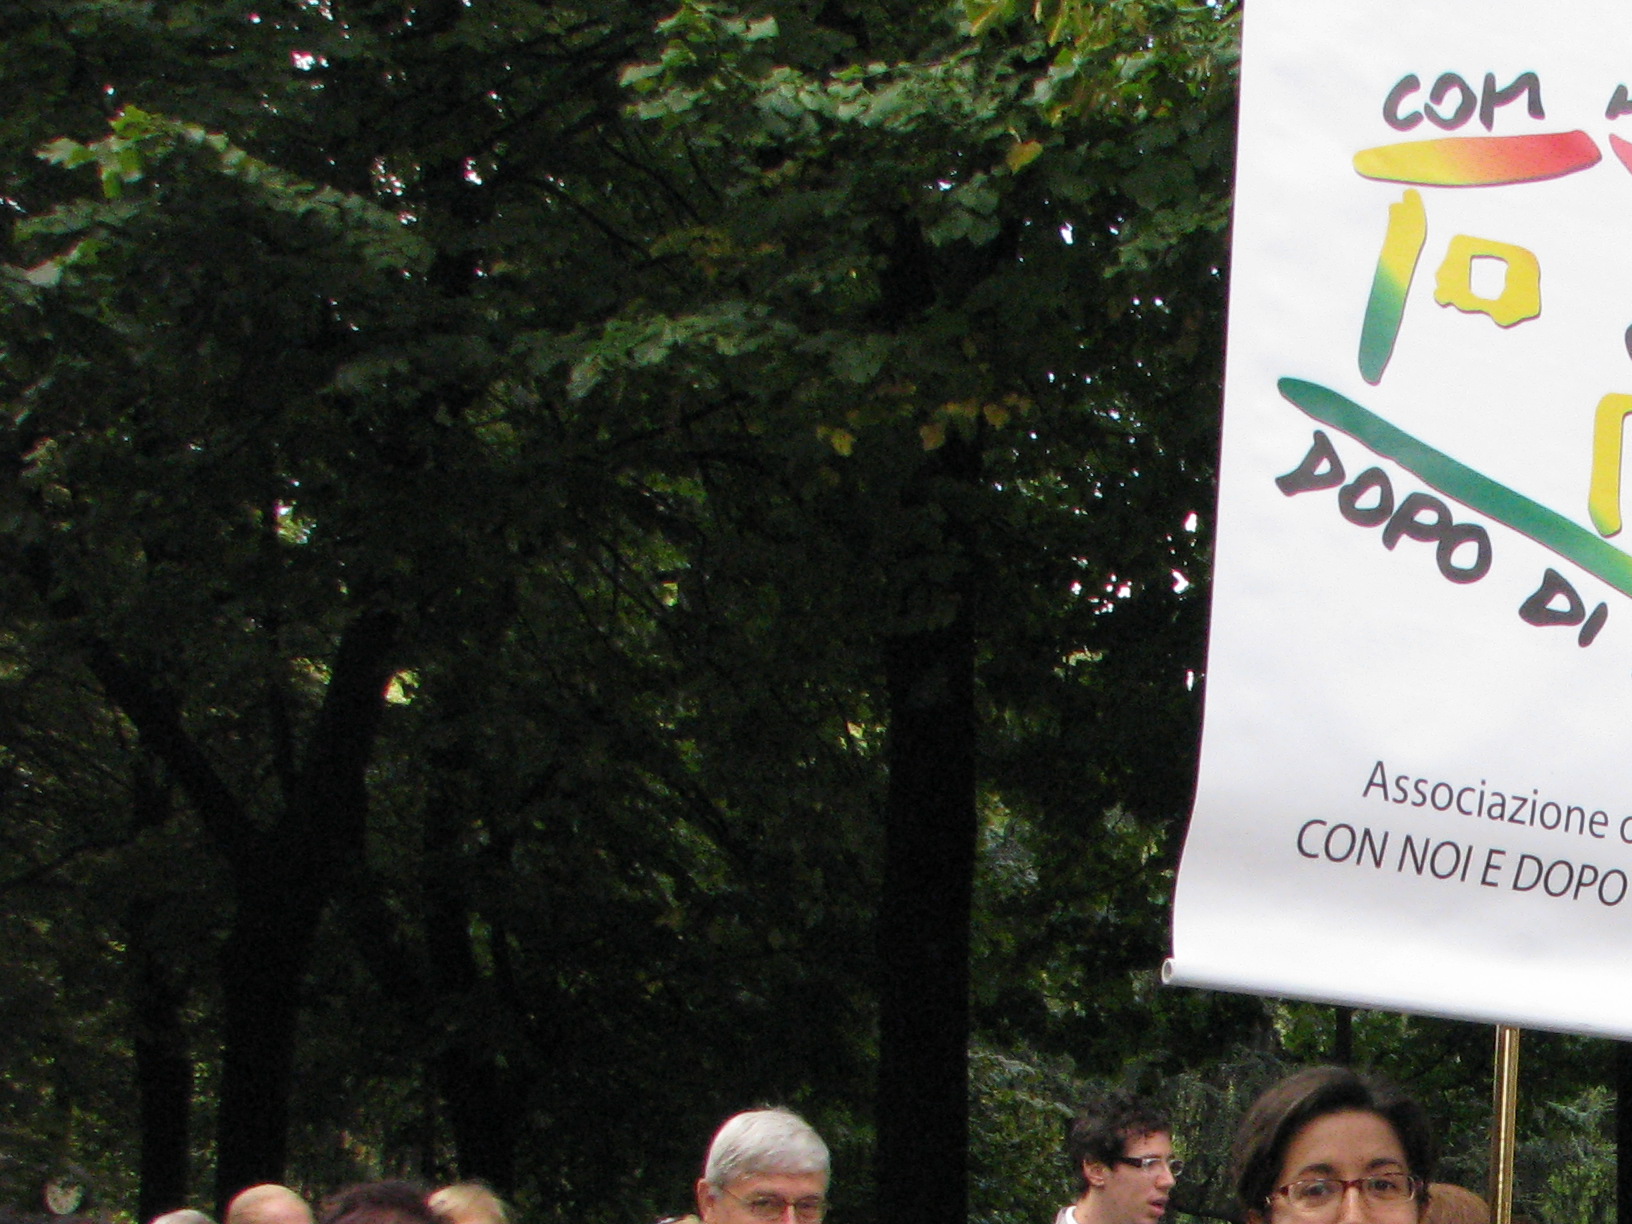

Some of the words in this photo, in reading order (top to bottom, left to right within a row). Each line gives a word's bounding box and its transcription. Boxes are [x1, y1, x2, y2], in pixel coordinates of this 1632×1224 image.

[1275, 430, 1493, 584] DOPO
[1518, 568, 1609, 647] DI
[1362, 760, 1610, 839] Associazione
[1296, 819, 1389, 869] CON
[1397, 834, 1474, 883] NOI
[1480, 848, 1507, 888] E
[1512, 853, 1628, 907] DOPO
